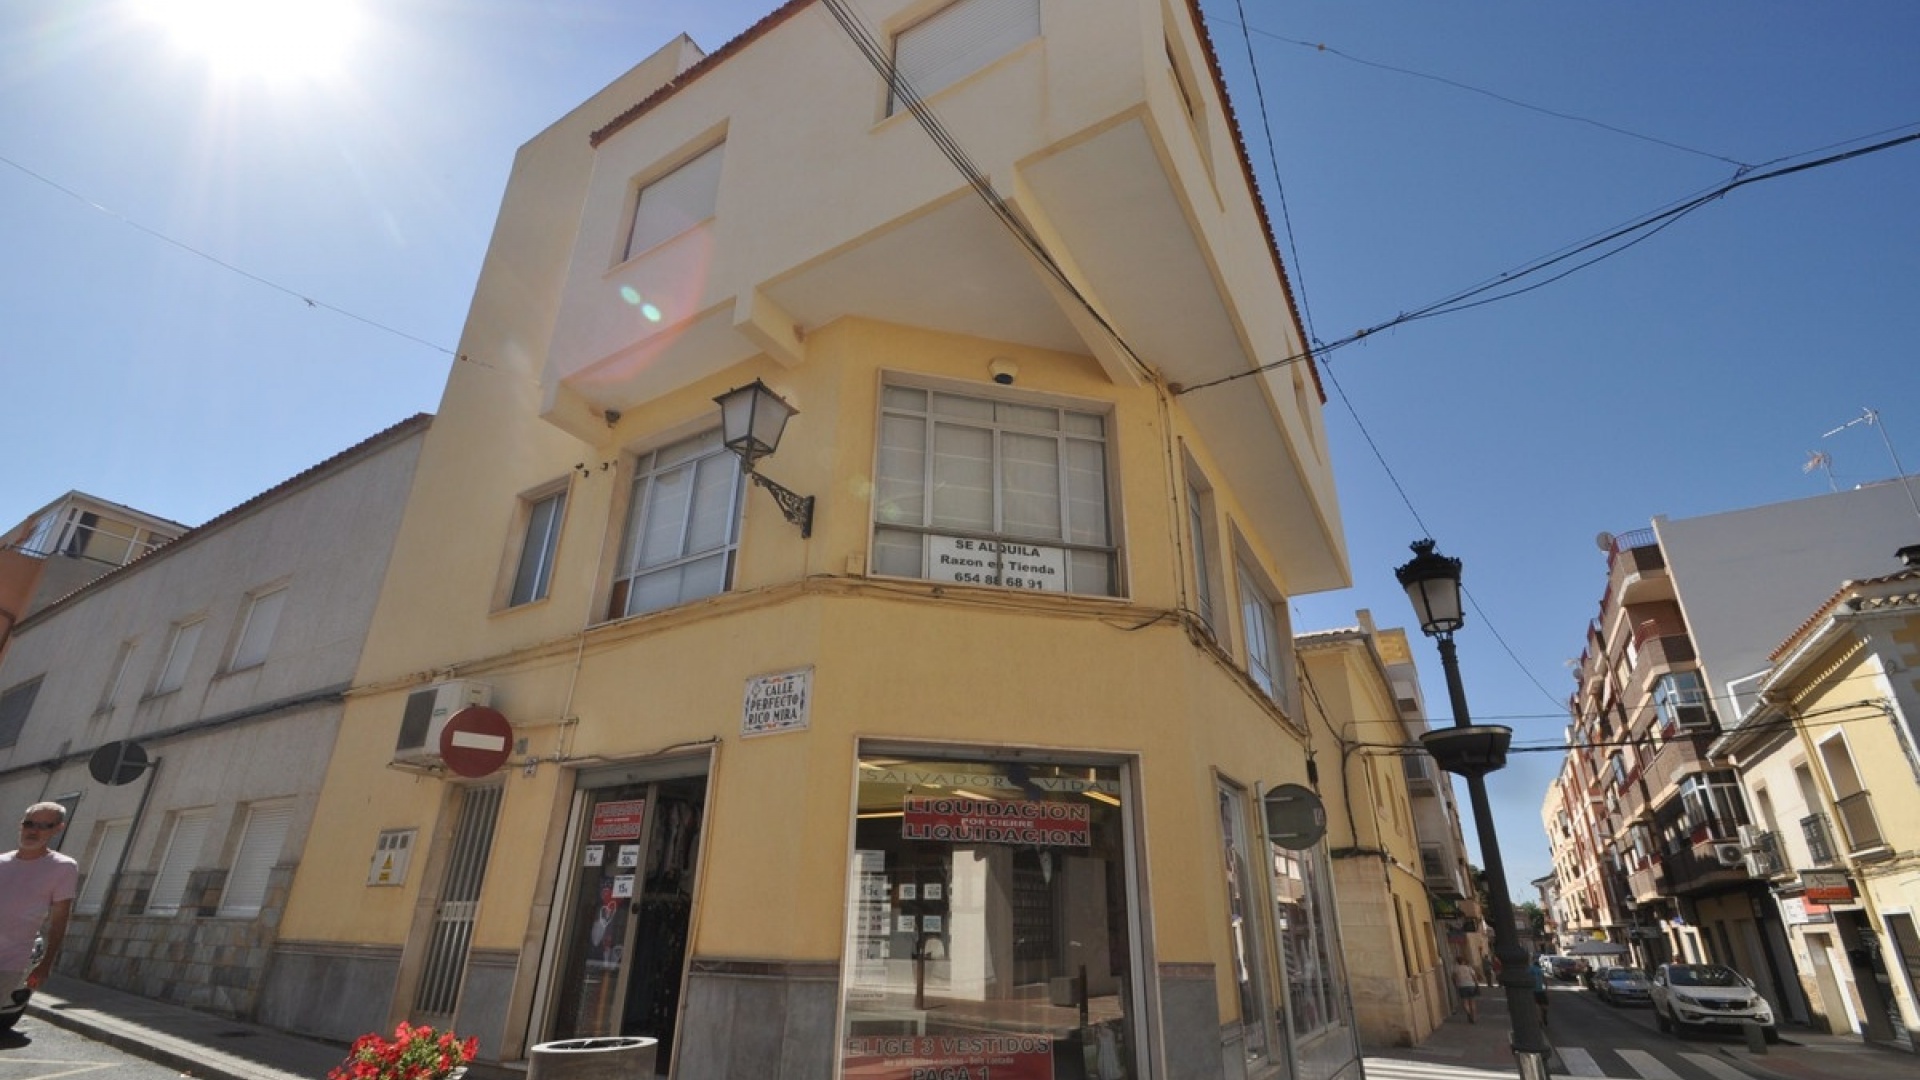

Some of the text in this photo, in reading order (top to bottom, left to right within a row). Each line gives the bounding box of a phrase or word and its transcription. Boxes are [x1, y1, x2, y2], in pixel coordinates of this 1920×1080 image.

[955, 540, 1041, 557] SE ALQUILA
[940, 554, 983, 567] Razon
[1008, 562, 1055, 575] Tienda
[954, 572, 980, 583] 654
[1006, 577, 1023, 588] 68
[1027, 579, 1043, 589] 91
[765, 682, 794, 696] CALLE
[750, 694, 799, 711] PERFECTO
[773, 708, 797, 721] MIRA
[866, 768, 1116, 792] SALVADOR VIDAL
[907, 799, 1088, 820] LIQUIDACION
[961, 817, 1034, 828] POR CIERRE
[907, 824, 1088, 844] LIQUIDACION
[847, 1036, 1051, 1056] ELIGE 3 VESTIDOS
[911, 1065, 972, 1080] PAGA
